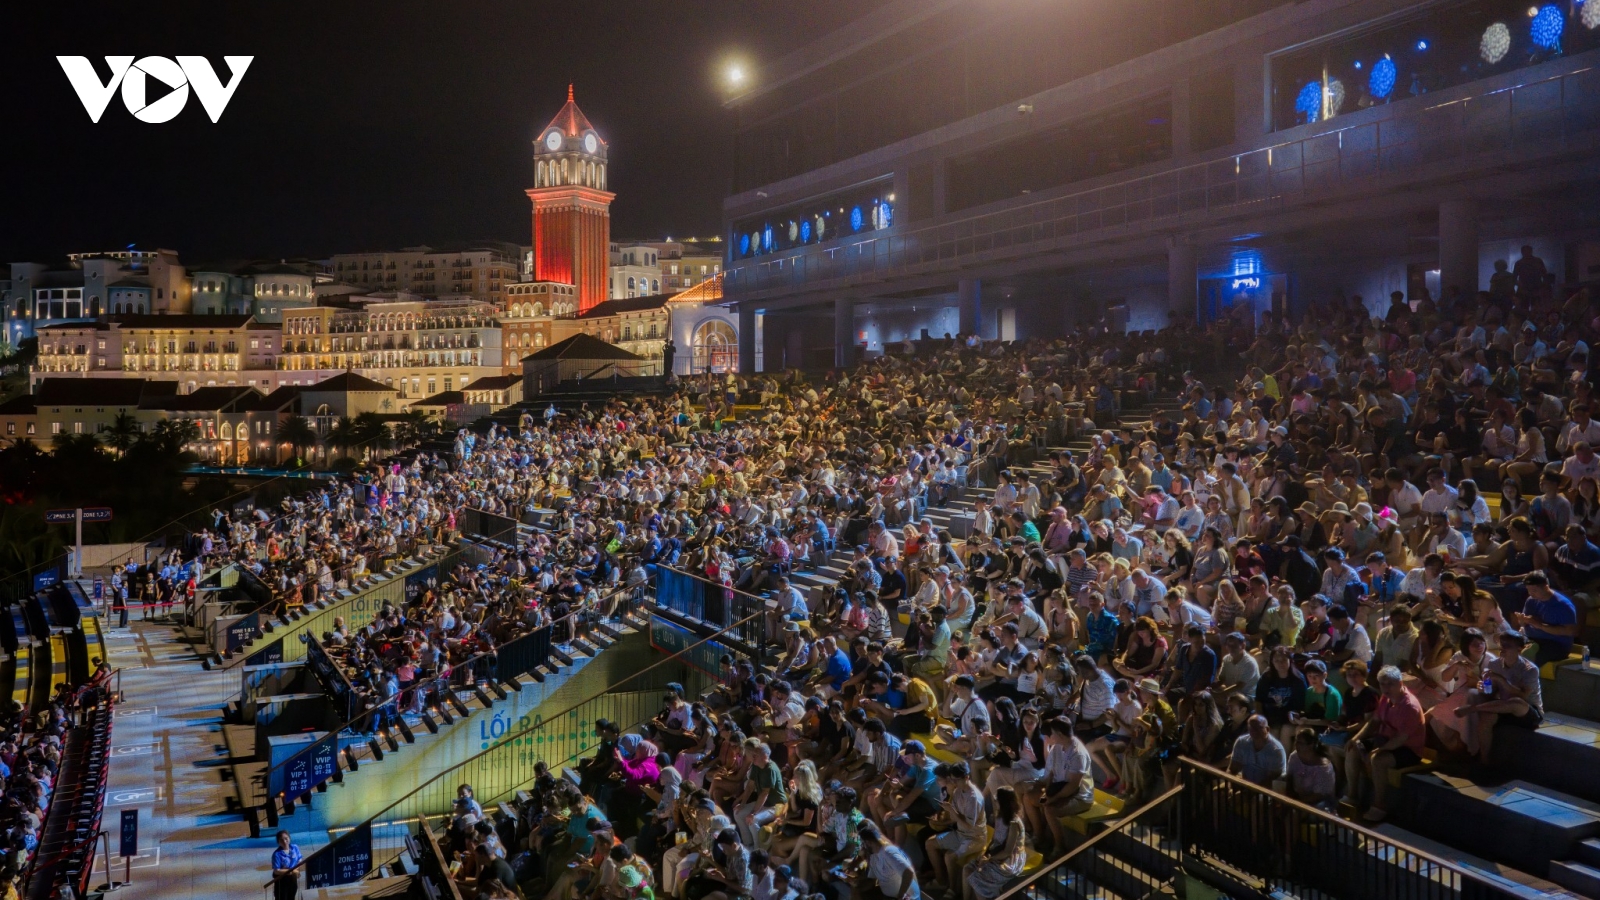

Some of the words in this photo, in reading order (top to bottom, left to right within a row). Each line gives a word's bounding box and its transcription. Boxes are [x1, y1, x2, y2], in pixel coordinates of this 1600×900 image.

[480, 709, 511, 740] LỐI
[315, 756, 332, 764] VVIP
[338, 855, 355, 864] ZONE
[311, 874, 323, 882] VIP
